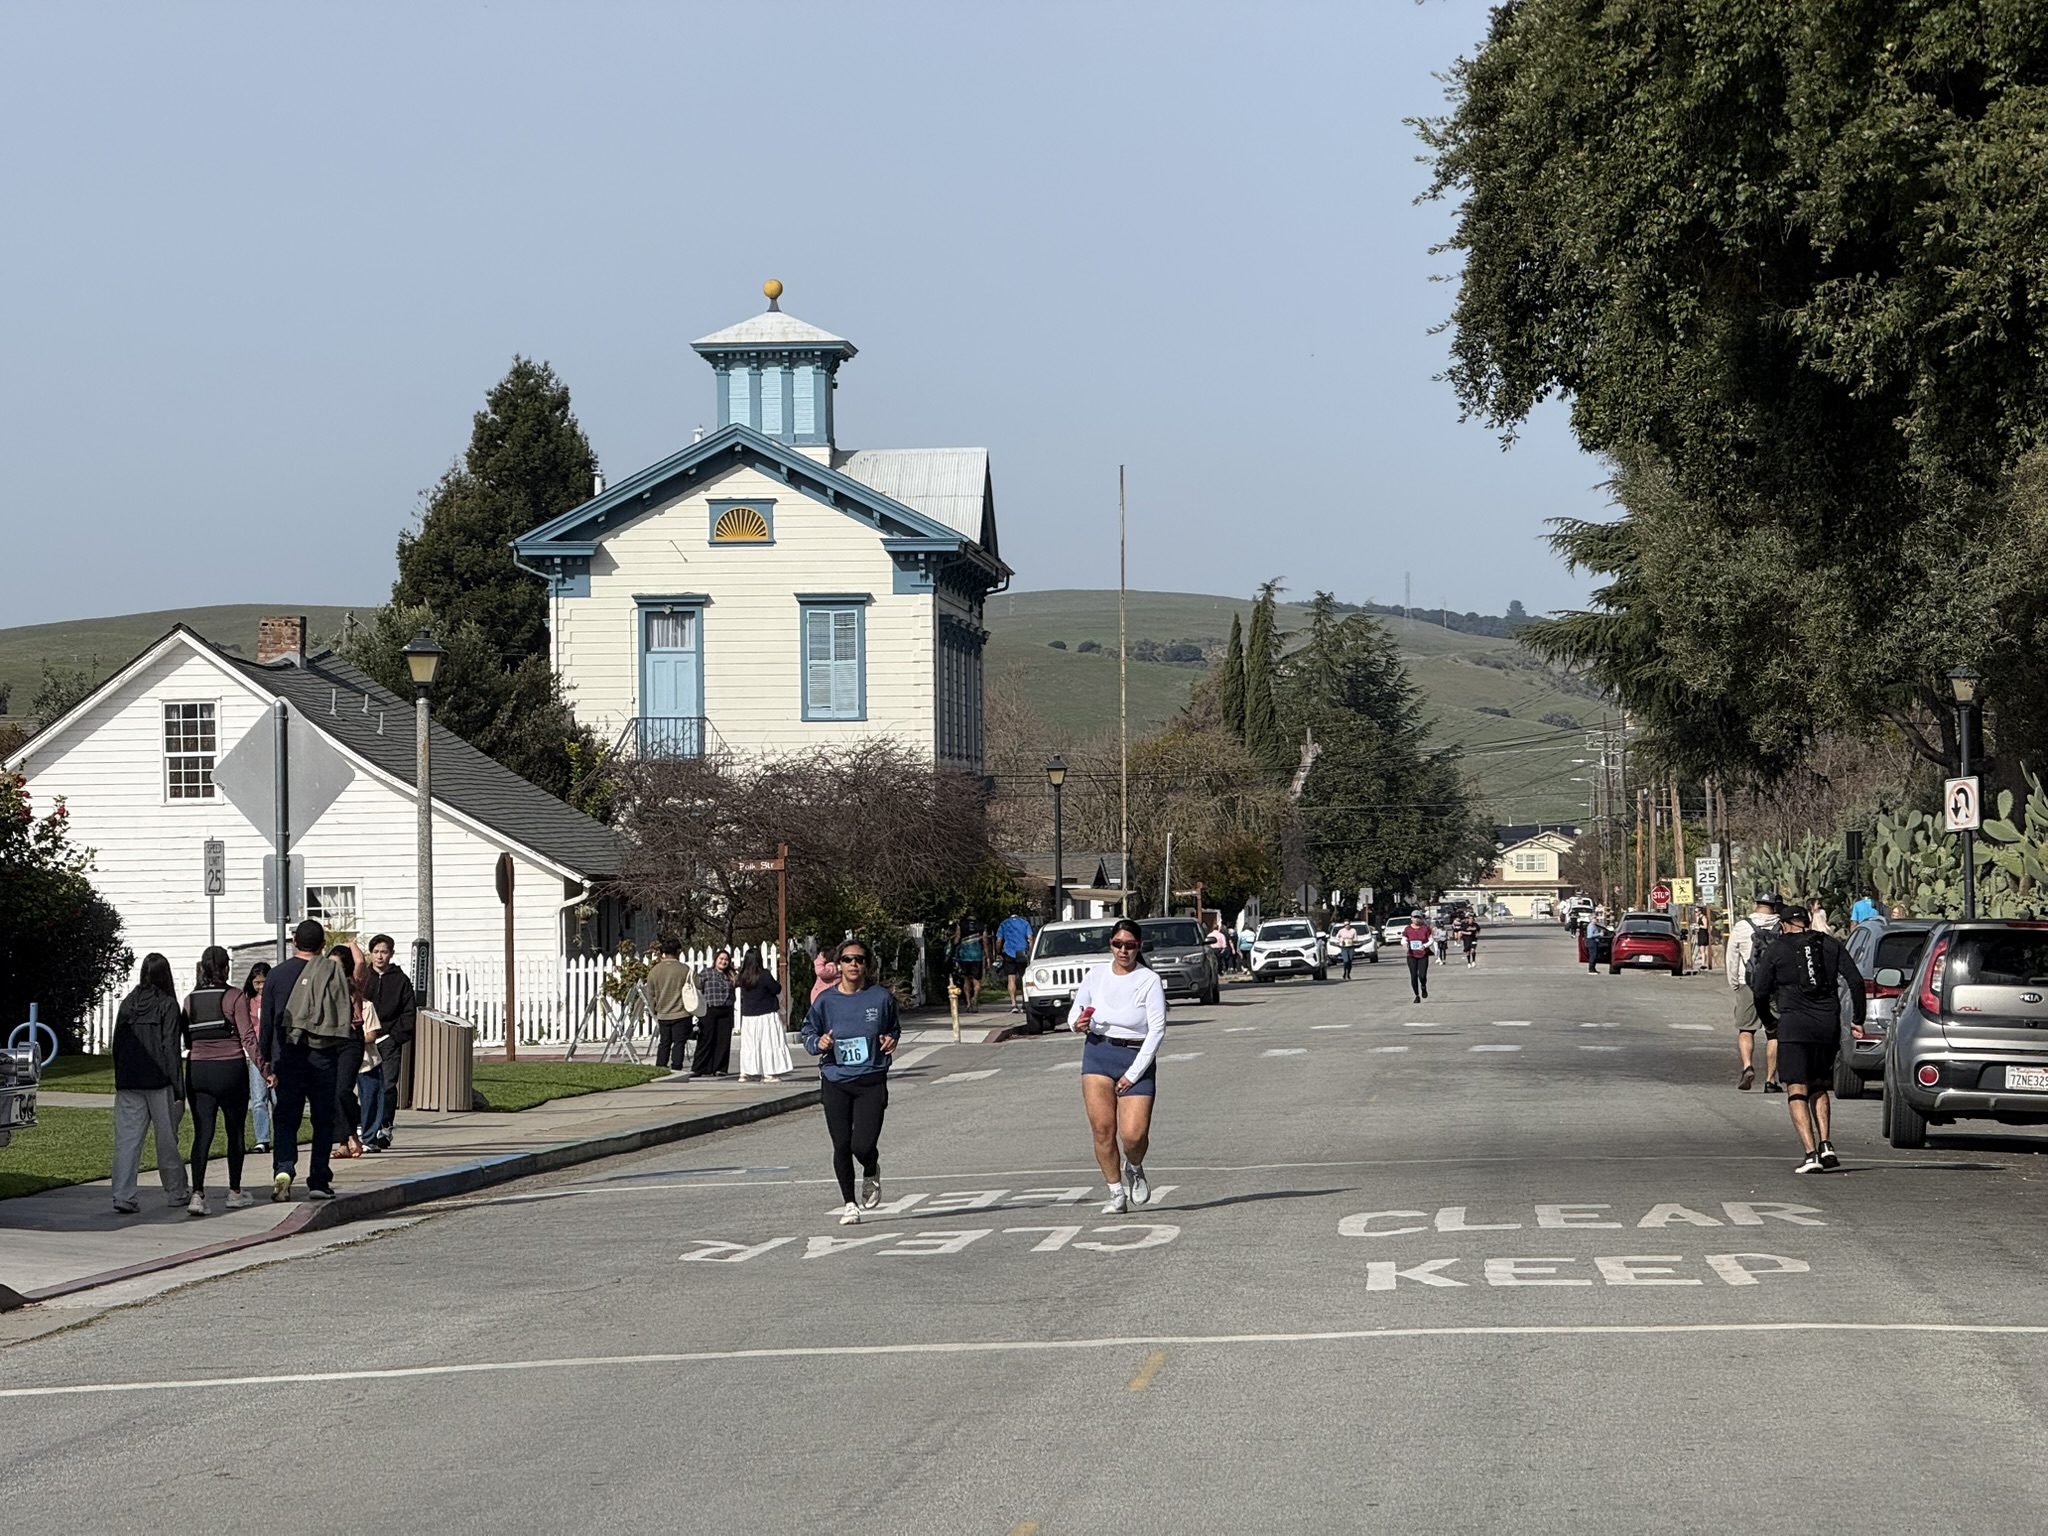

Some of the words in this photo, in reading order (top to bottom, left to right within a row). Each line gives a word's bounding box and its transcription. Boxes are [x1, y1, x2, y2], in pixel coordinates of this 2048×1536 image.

[207, 844, 221, 853] SPEED
[208, 869, 221, 892] 25
[1698, 873, 1716, 883] 25
[1653, 891, 1669, 899] STOP
[2024, 994, 2040, 1002] KIA
[840, 1048, 861, 1062] 216
[1337, 1201, 1828, 1238] CLEAR
[678, 1225, 1181, 1263] CLEAR
[1365, 1252, 1810, 1291] KEEP
